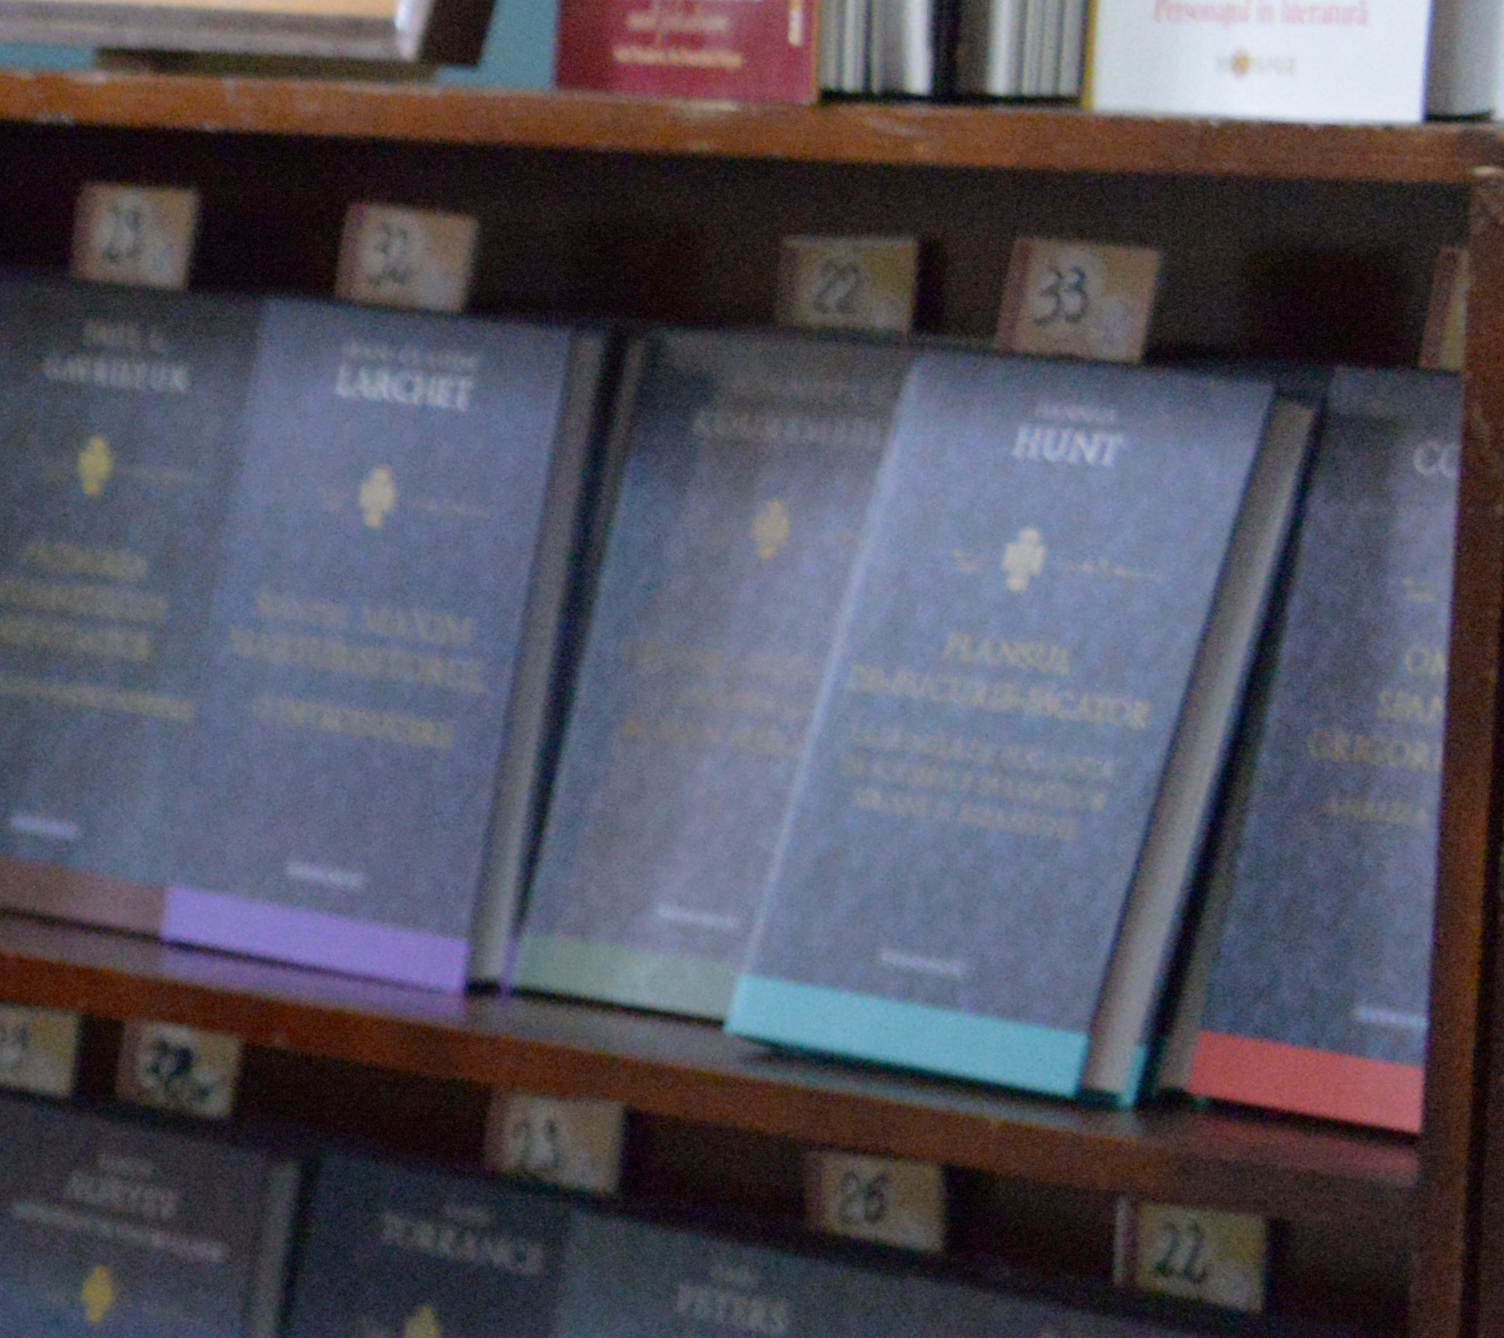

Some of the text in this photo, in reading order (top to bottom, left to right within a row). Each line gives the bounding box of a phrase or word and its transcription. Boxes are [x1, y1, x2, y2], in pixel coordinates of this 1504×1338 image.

[811, 261, 863, 315] 22
[1032, 265, 1090, 326] 33
[1010, 424, 1129, 470] HUNT
[838, 1169, 887, 1224] 26
[1152, 1222, 1209, 1285] 22
